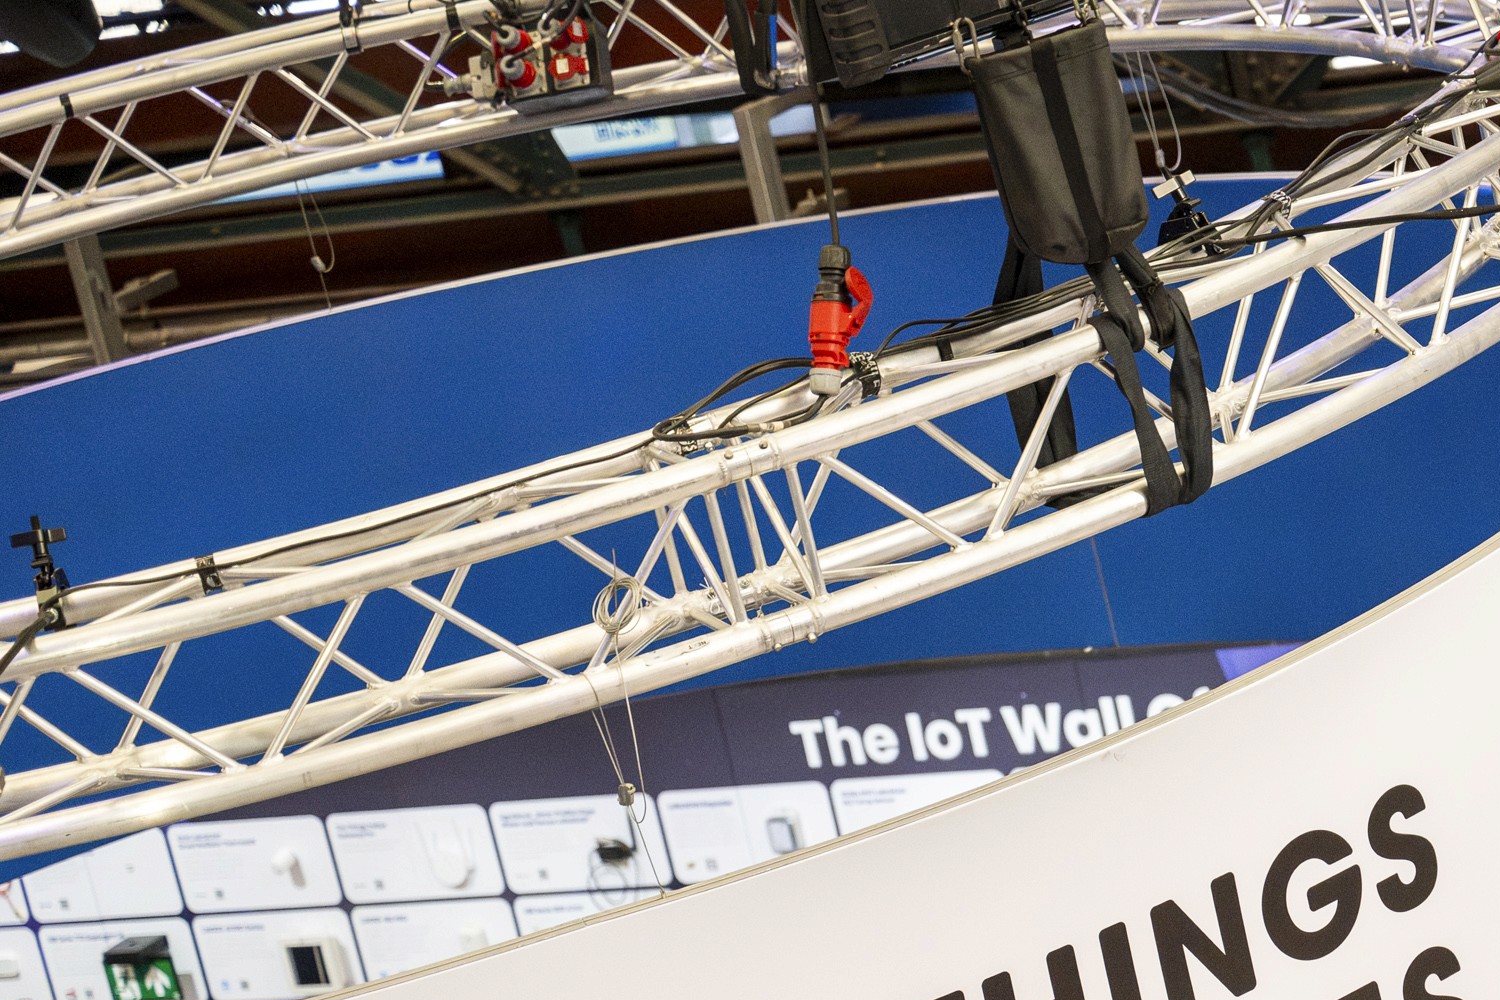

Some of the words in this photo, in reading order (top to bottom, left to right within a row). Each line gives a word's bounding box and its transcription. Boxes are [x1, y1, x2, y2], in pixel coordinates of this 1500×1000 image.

[788, 716, 900, 769] The
[905, 707, 992, 762] IoT
[1000, 694, 1135, 754] Wall
